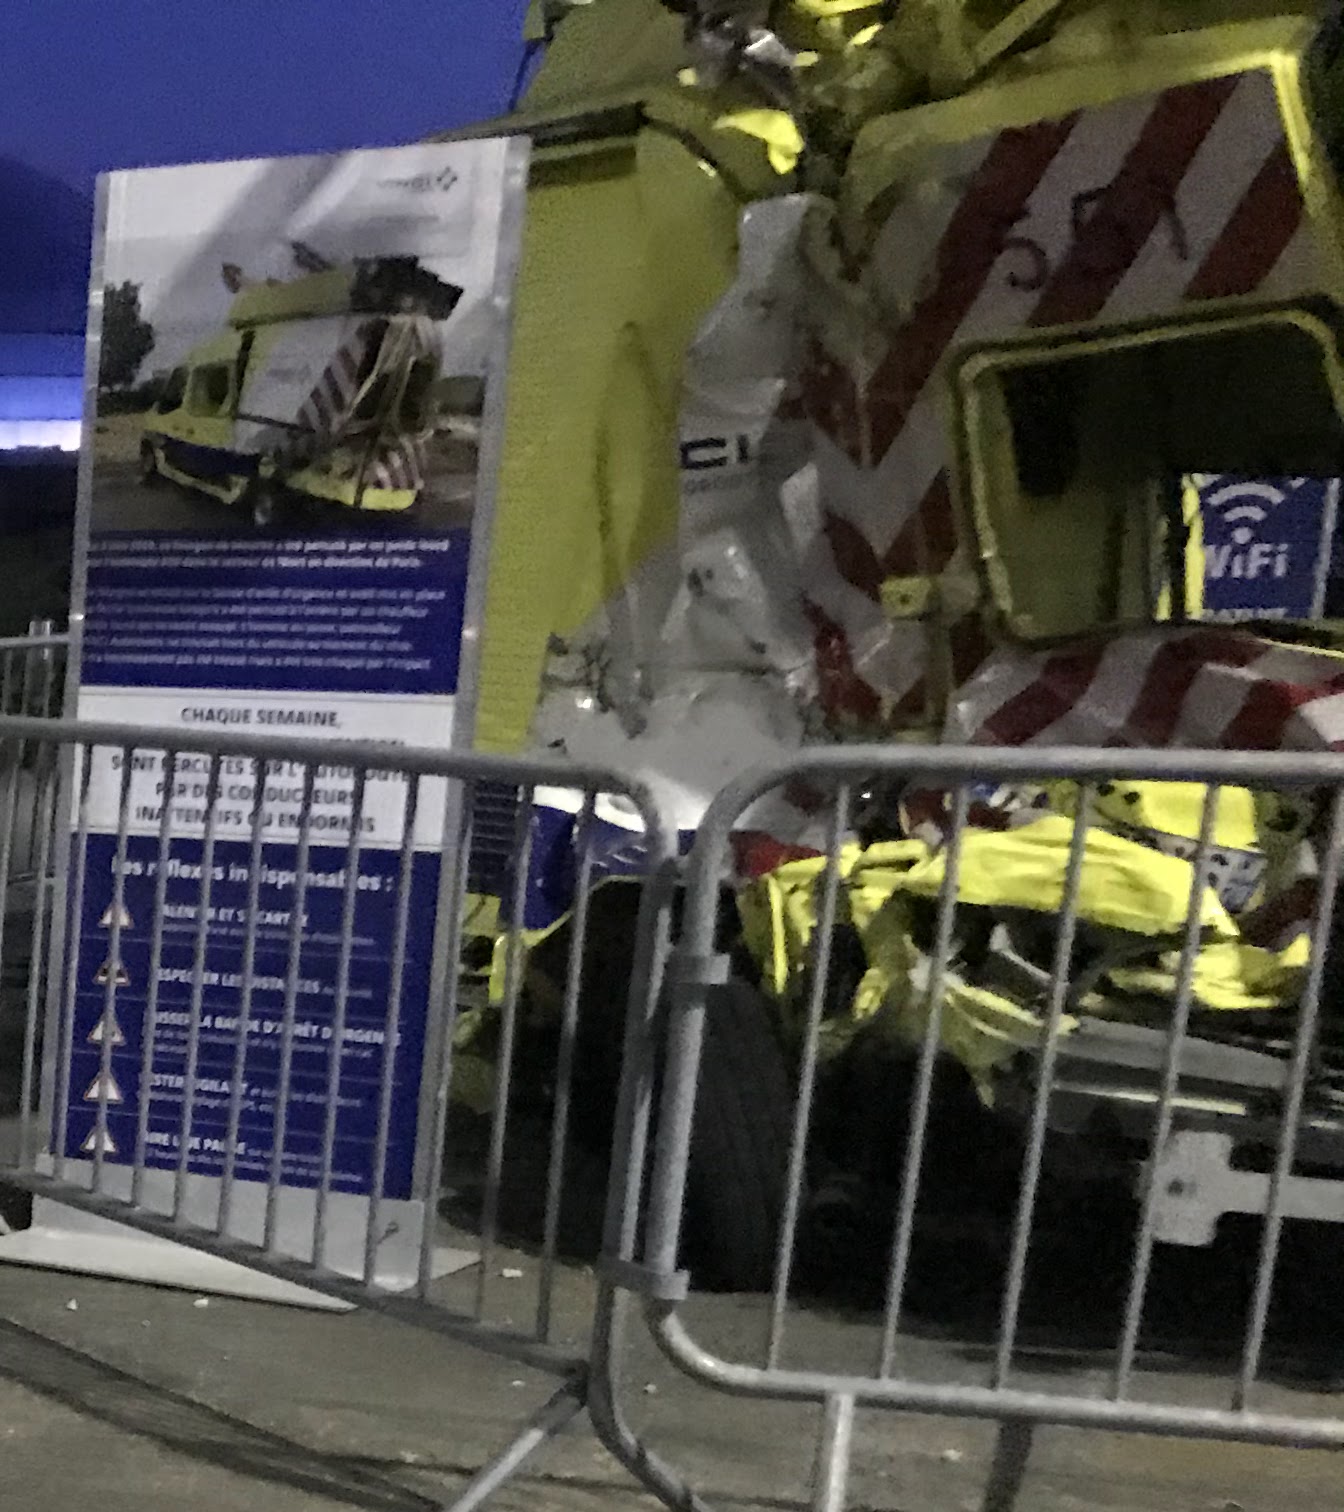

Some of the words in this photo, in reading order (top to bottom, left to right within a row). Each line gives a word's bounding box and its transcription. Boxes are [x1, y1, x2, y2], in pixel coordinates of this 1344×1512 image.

[1201, 543, 1289, 579] WiFi
[181, 707, 252, 725] CHAQUE
[256, 709, 343, 729] SEMAINE,
[112, 755, 156, 771] SNT
[162, 757, 244, 776] ERCUS
[250, 760, 283, 776] SR
[288, 761, 412, 782] L'UTOOUTE
[156, 782, 187, 798] PR
[193, 784, 223, 798] DS
[228, 785, 360, 806] CODUCEUR
[135, 806, 243, 826] INATENIFS
[278, 813, 375, 833] ENORMS
[147, 859, 224, 881] rflexs
[228, 862, 381, 890] inispnsaes
[155, 904, 216, 920] ALENR
[237, 910, 308, 927] SCARTR
[152, 968, 219, 985] ESPECER
[245, 976, 320, 994] ISTAES
[214, 1016, 259, 1033] BANE
[263, 1019, 319, 1038] D'ARÊT
[321, 1026, 401, 1047] DRGENE
[140, 1073, 184, 1089] STER
[187, 1078, 249, 1095] GILAT
[138, 1131, 170, 1147] AIRE
[172, 1135, 201, 1150] UE
[203, 1138, 246, 1154] PAUE
